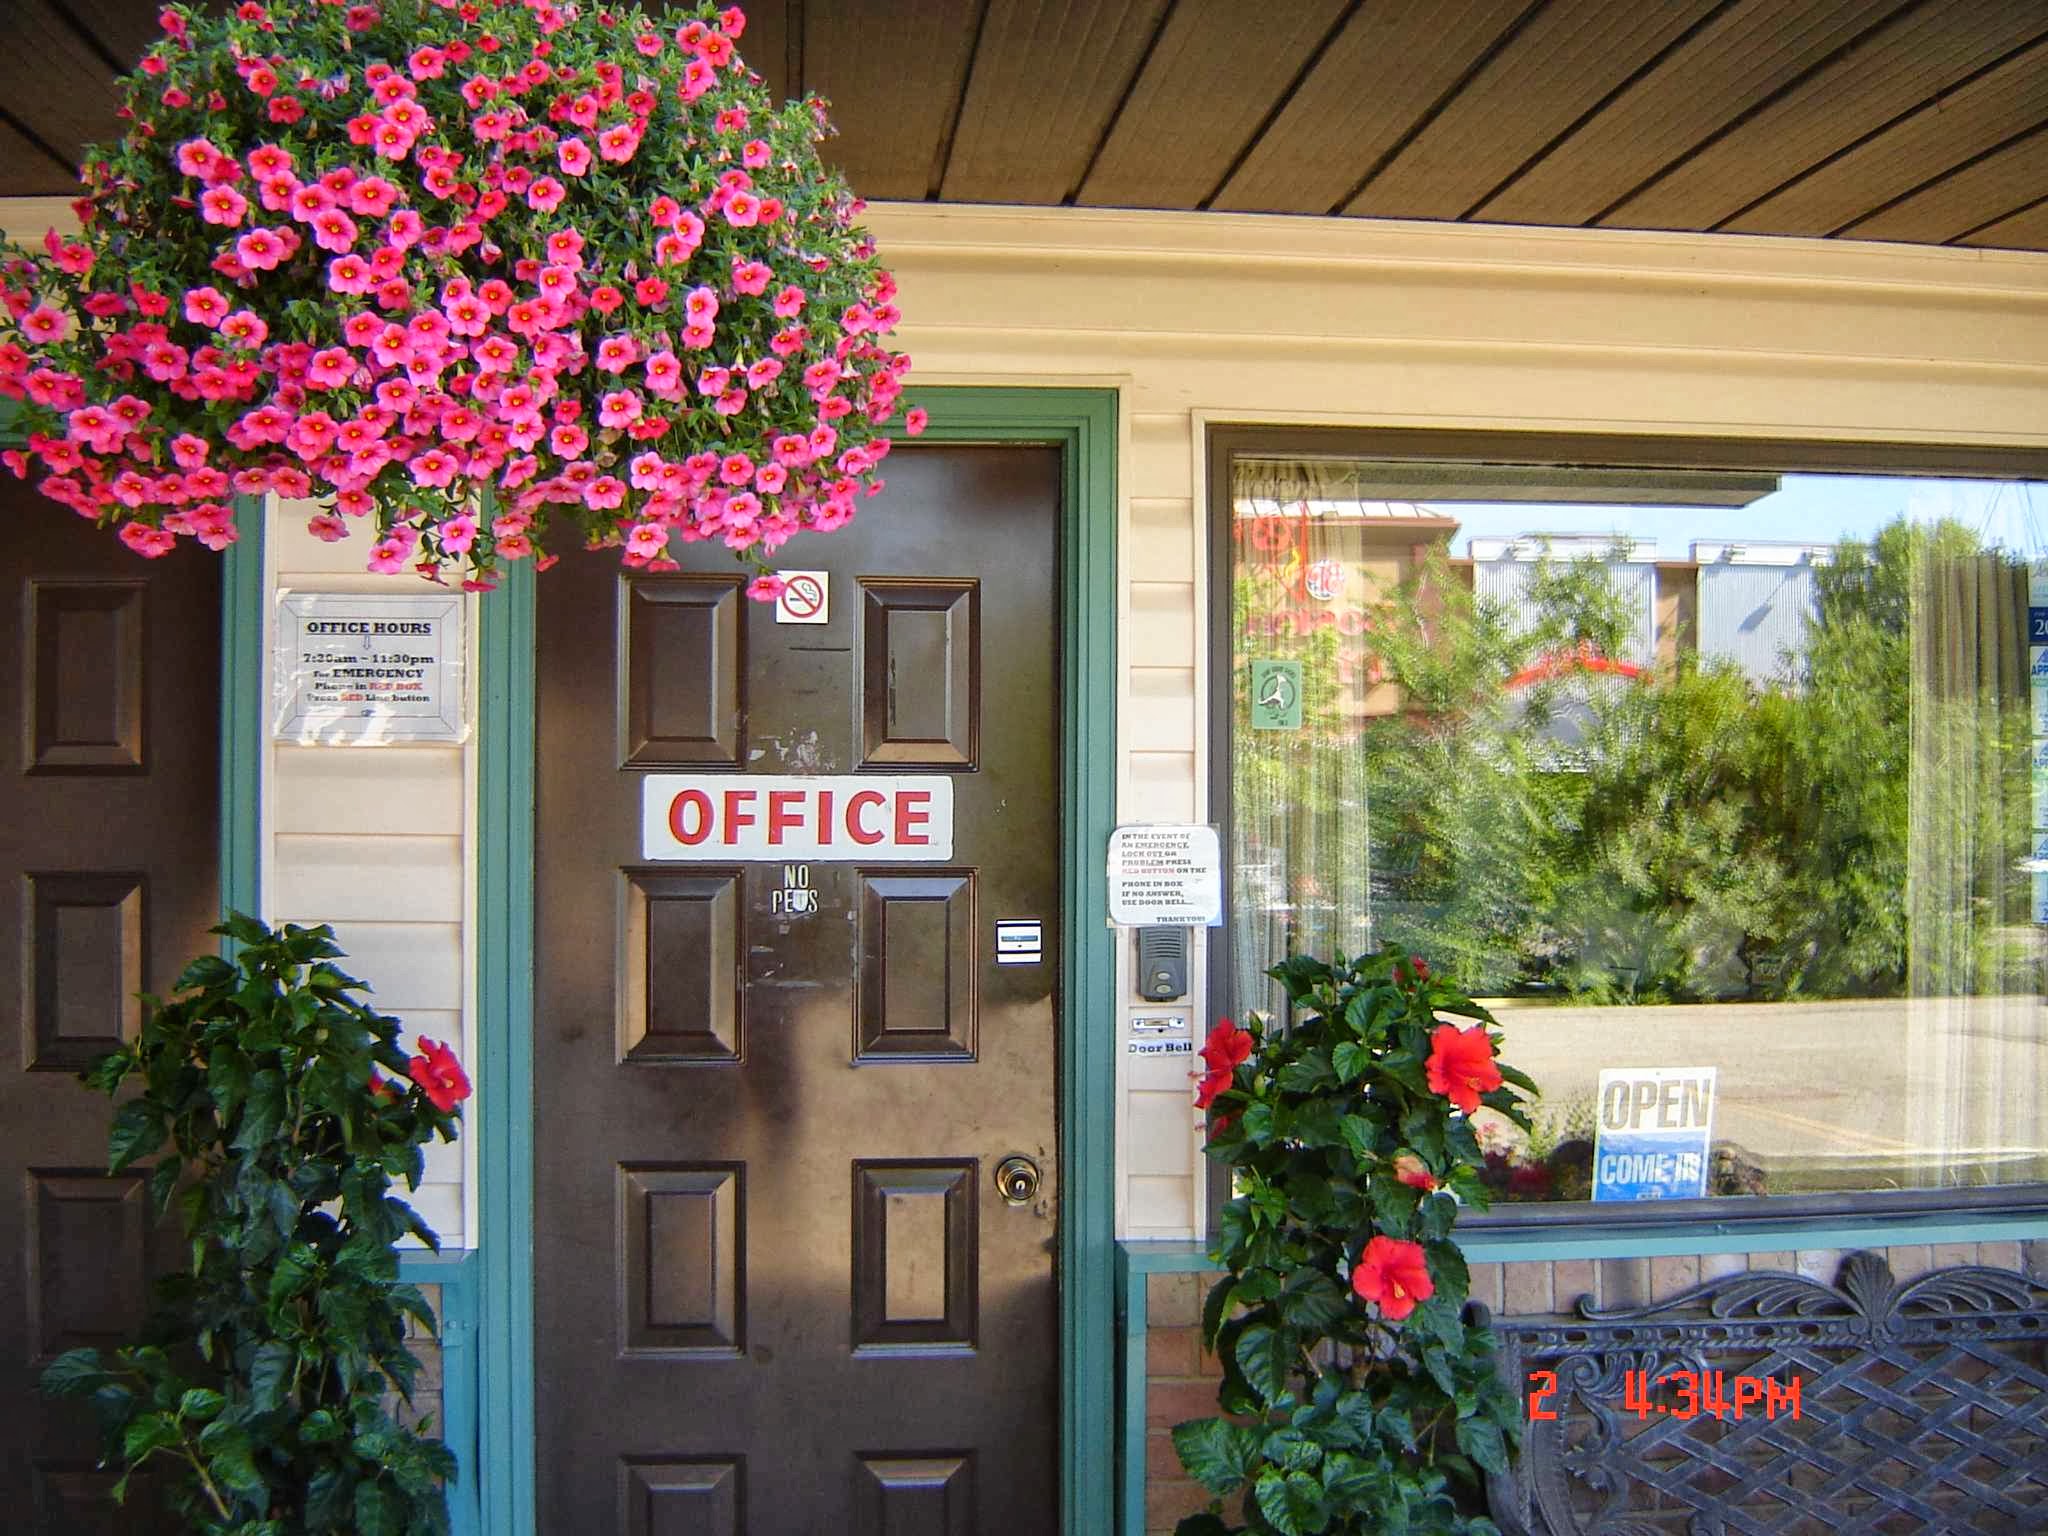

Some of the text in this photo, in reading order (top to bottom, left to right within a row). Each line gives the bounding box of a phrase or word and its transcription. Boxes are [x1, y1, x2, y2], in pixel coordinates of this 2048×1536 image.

[307, 622, 432, 634] OFFICE HOURS
[333, 668, 425, 678] EMERGENCY
[668, 789, 932, 846] OFFICE
[783, 864, 809, 889] NO
[772, 888, 818, 913] PES
[1128, 1043, 1192, 1053] Door Bell
[1601, 1079, 1711, 1130] OPEN
[1600, 1151, 1701, 1185] COME IN
